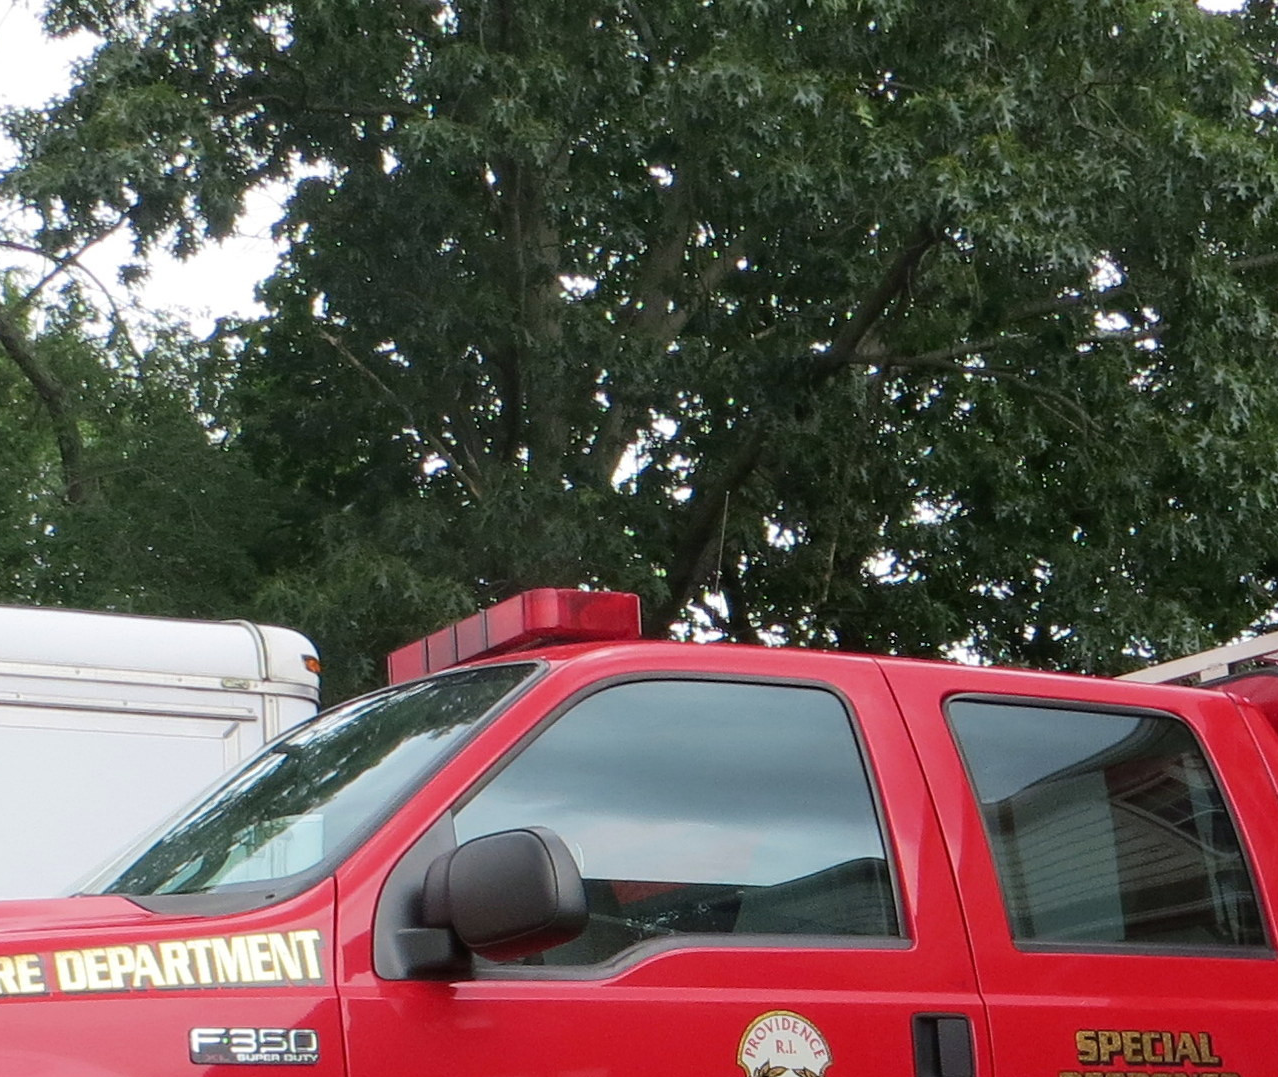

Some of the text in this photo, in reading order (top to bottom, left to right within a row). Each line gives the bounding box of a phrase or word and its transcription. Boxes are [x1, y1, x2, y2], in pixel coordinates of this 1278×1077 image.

[54, 929, 324, 992] DEPARTMENT
[236, 1053, 319, 1062] SUPER DUTY
[745, 1017, 826, 1059] PROVIDENCE
[1075, 1029, 1222, 1066] SPECIAL
